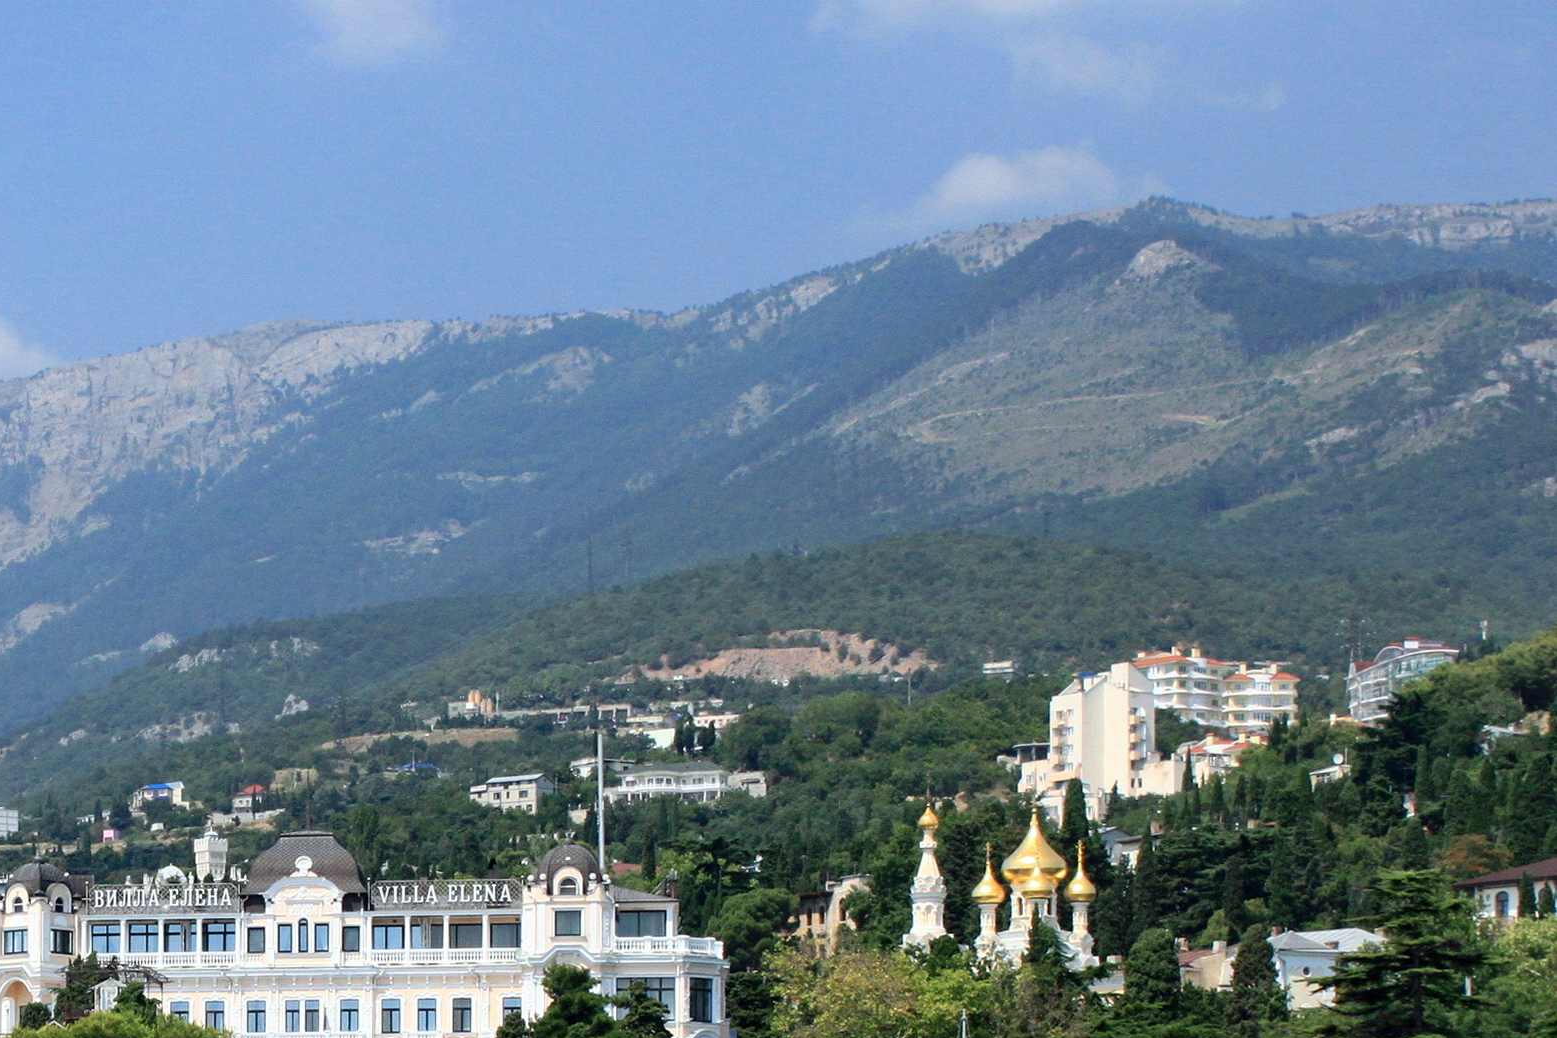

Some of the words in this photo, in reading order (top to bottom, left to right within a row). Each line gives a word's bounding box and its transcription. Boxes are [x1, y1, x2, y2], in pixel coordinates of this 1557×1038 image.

[94, 888, 160, 908] ВИЛЛА
[168, 887, 233, 907] ЕЛЕНА
[377, 884, 439, 904] VILLA
[447, 883, 513, 903] ELENA
